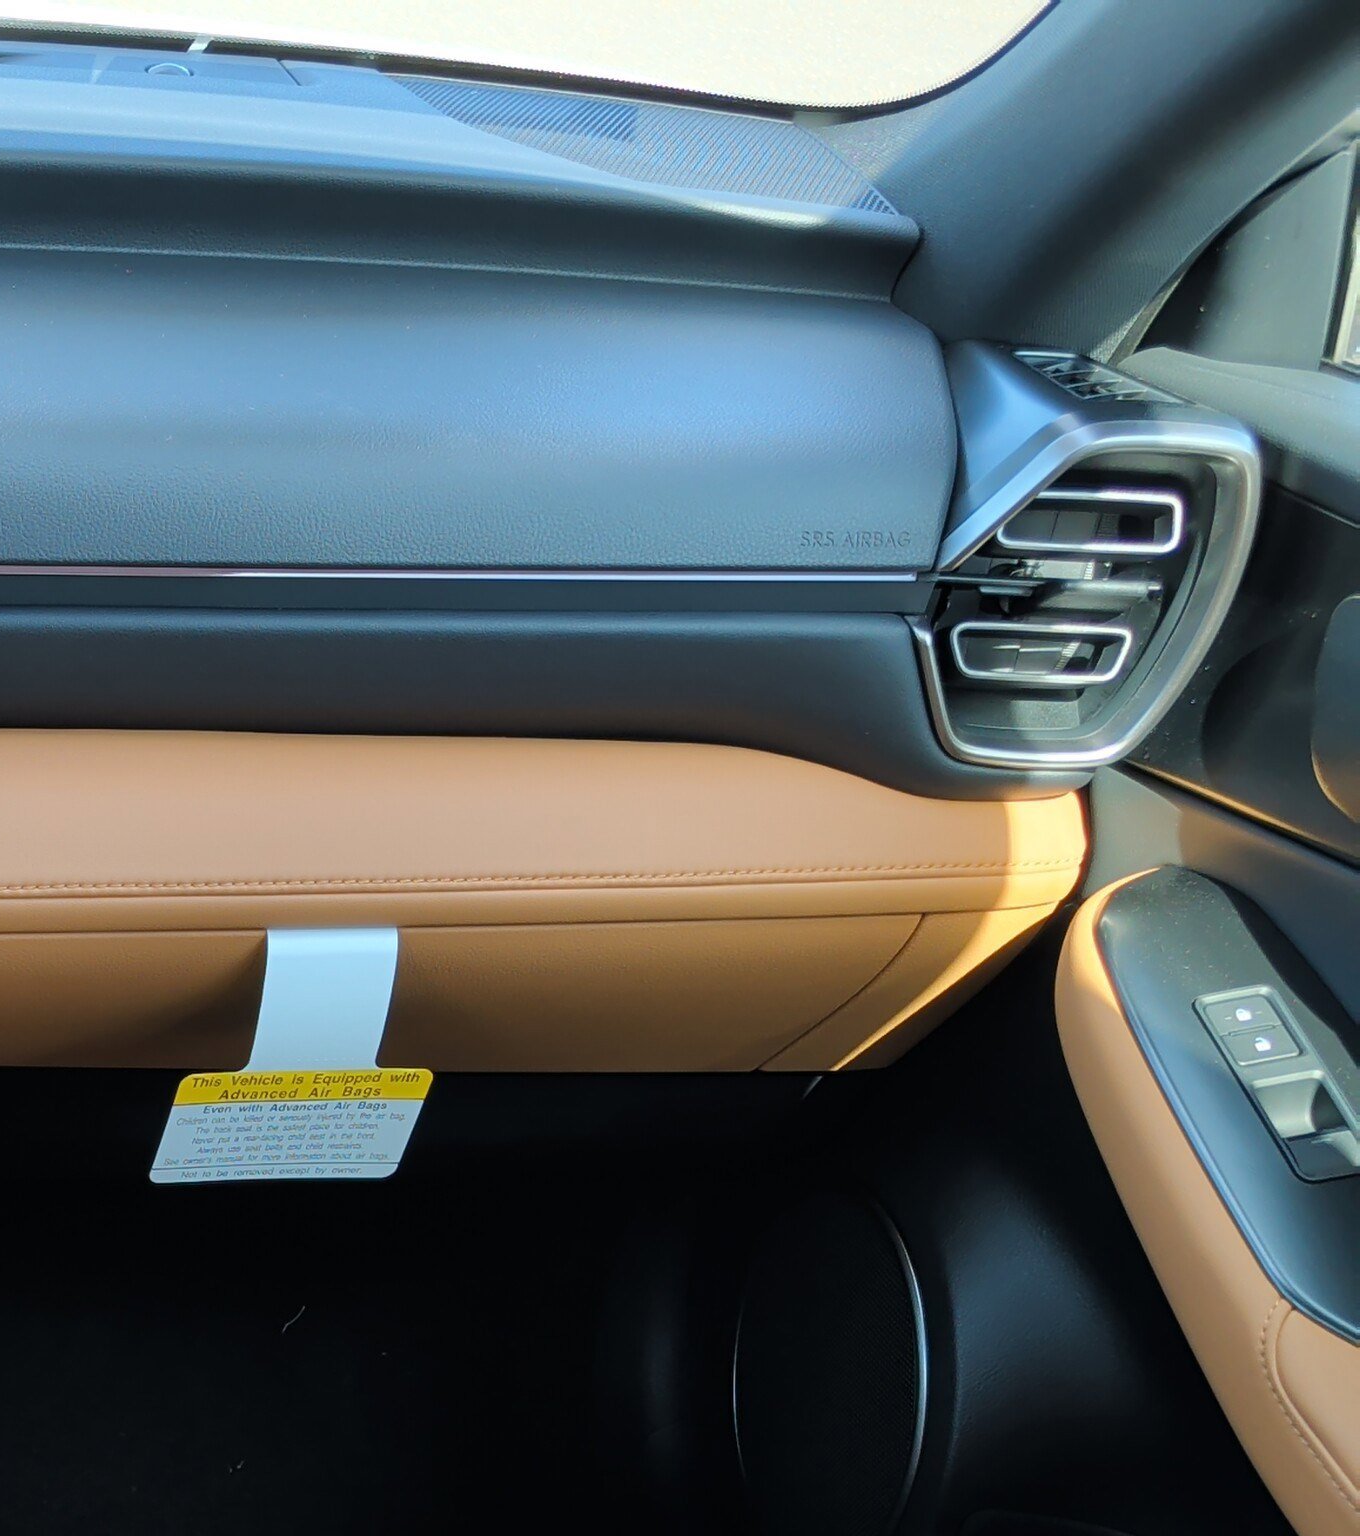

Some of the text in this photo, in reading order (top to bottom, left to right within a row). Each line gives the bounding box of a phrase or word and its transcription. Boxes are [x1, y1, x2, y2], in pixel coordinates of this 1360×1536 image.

[800, 530, 912, 549] SRS AIRBAG
[192, 1071, 421, 1088] This Vehicle is Equipped with
[218, 1085, 382, 1101] Advanced Air Bags
[202, 1101, 388, 1114] Even with Advanced Air Bags
